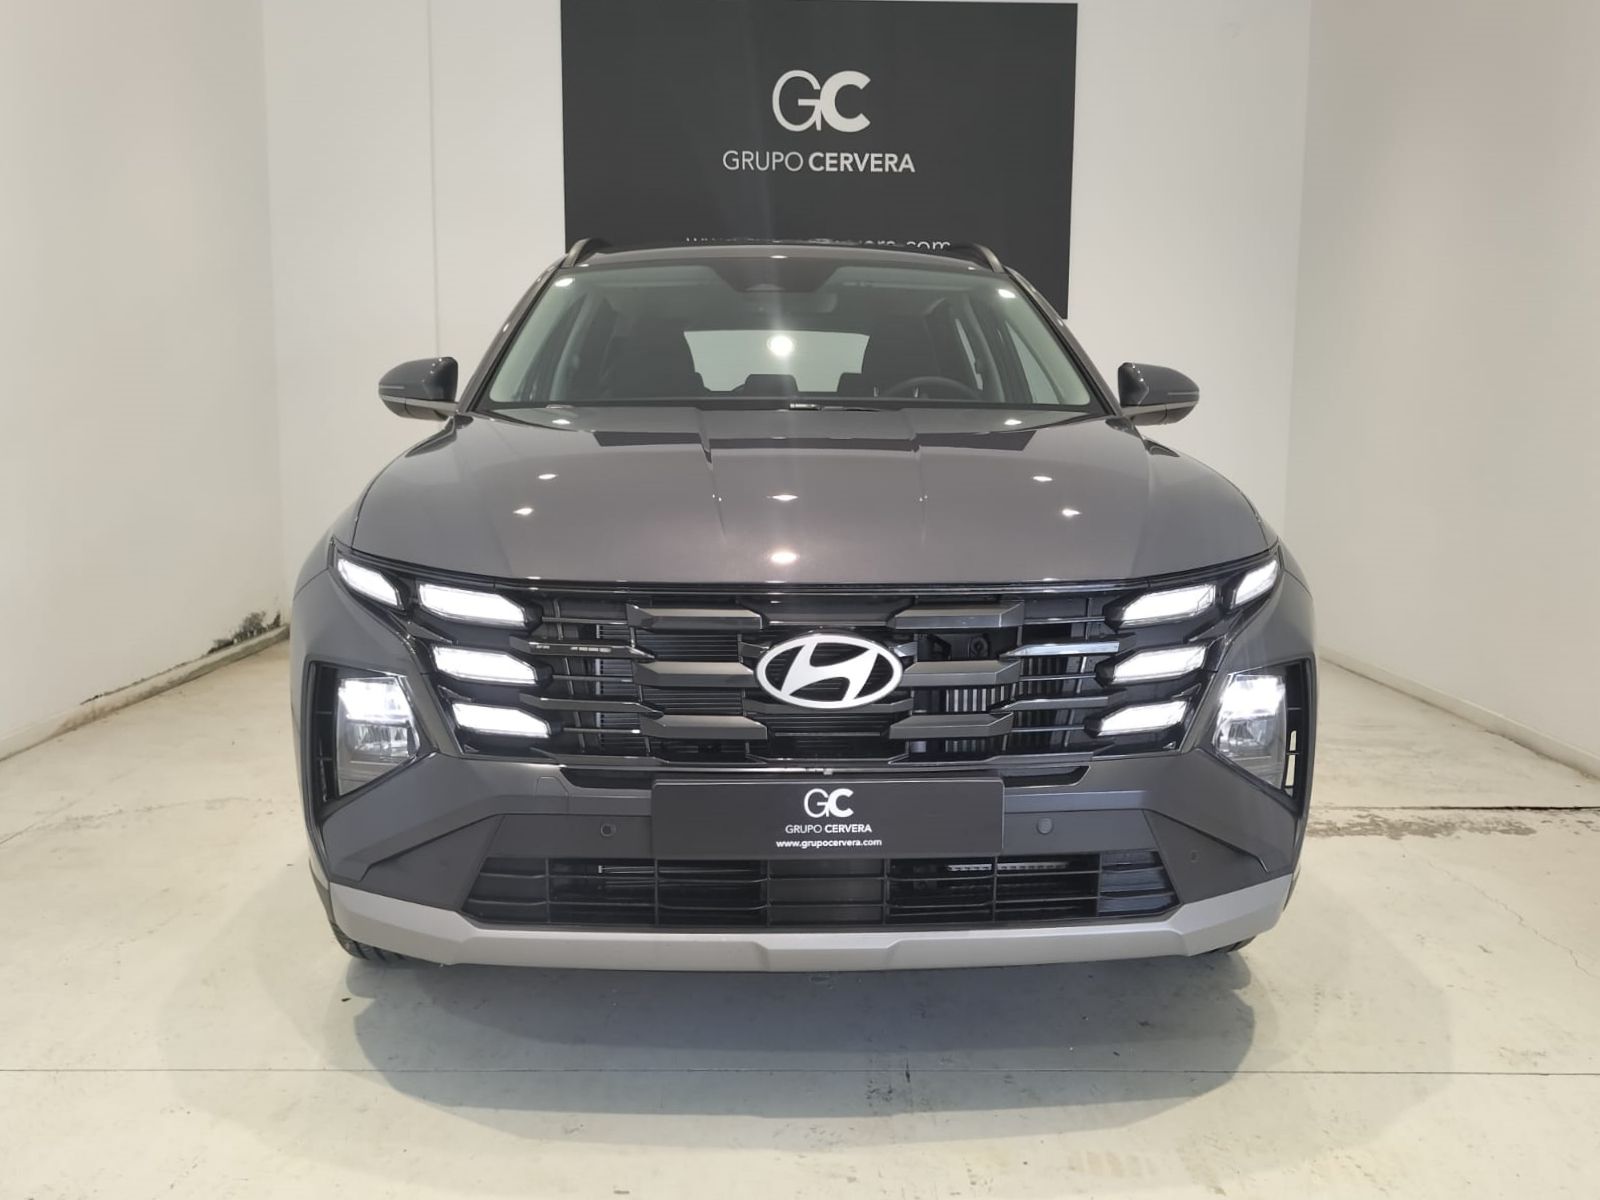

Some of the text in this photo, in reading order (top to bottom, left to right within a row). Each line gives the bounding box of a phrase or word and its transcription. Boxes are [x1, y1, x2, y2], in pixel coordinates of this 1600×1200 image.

[771, 69, 871, 133] GC
[722, 150, 916, 173] GRUPO CERVERA
[803, 788, 854, 818] GC
[785, 824, 872, 834] GRUPO CERVERA
[775, 839, 882, 849] www.grupocervera.com
